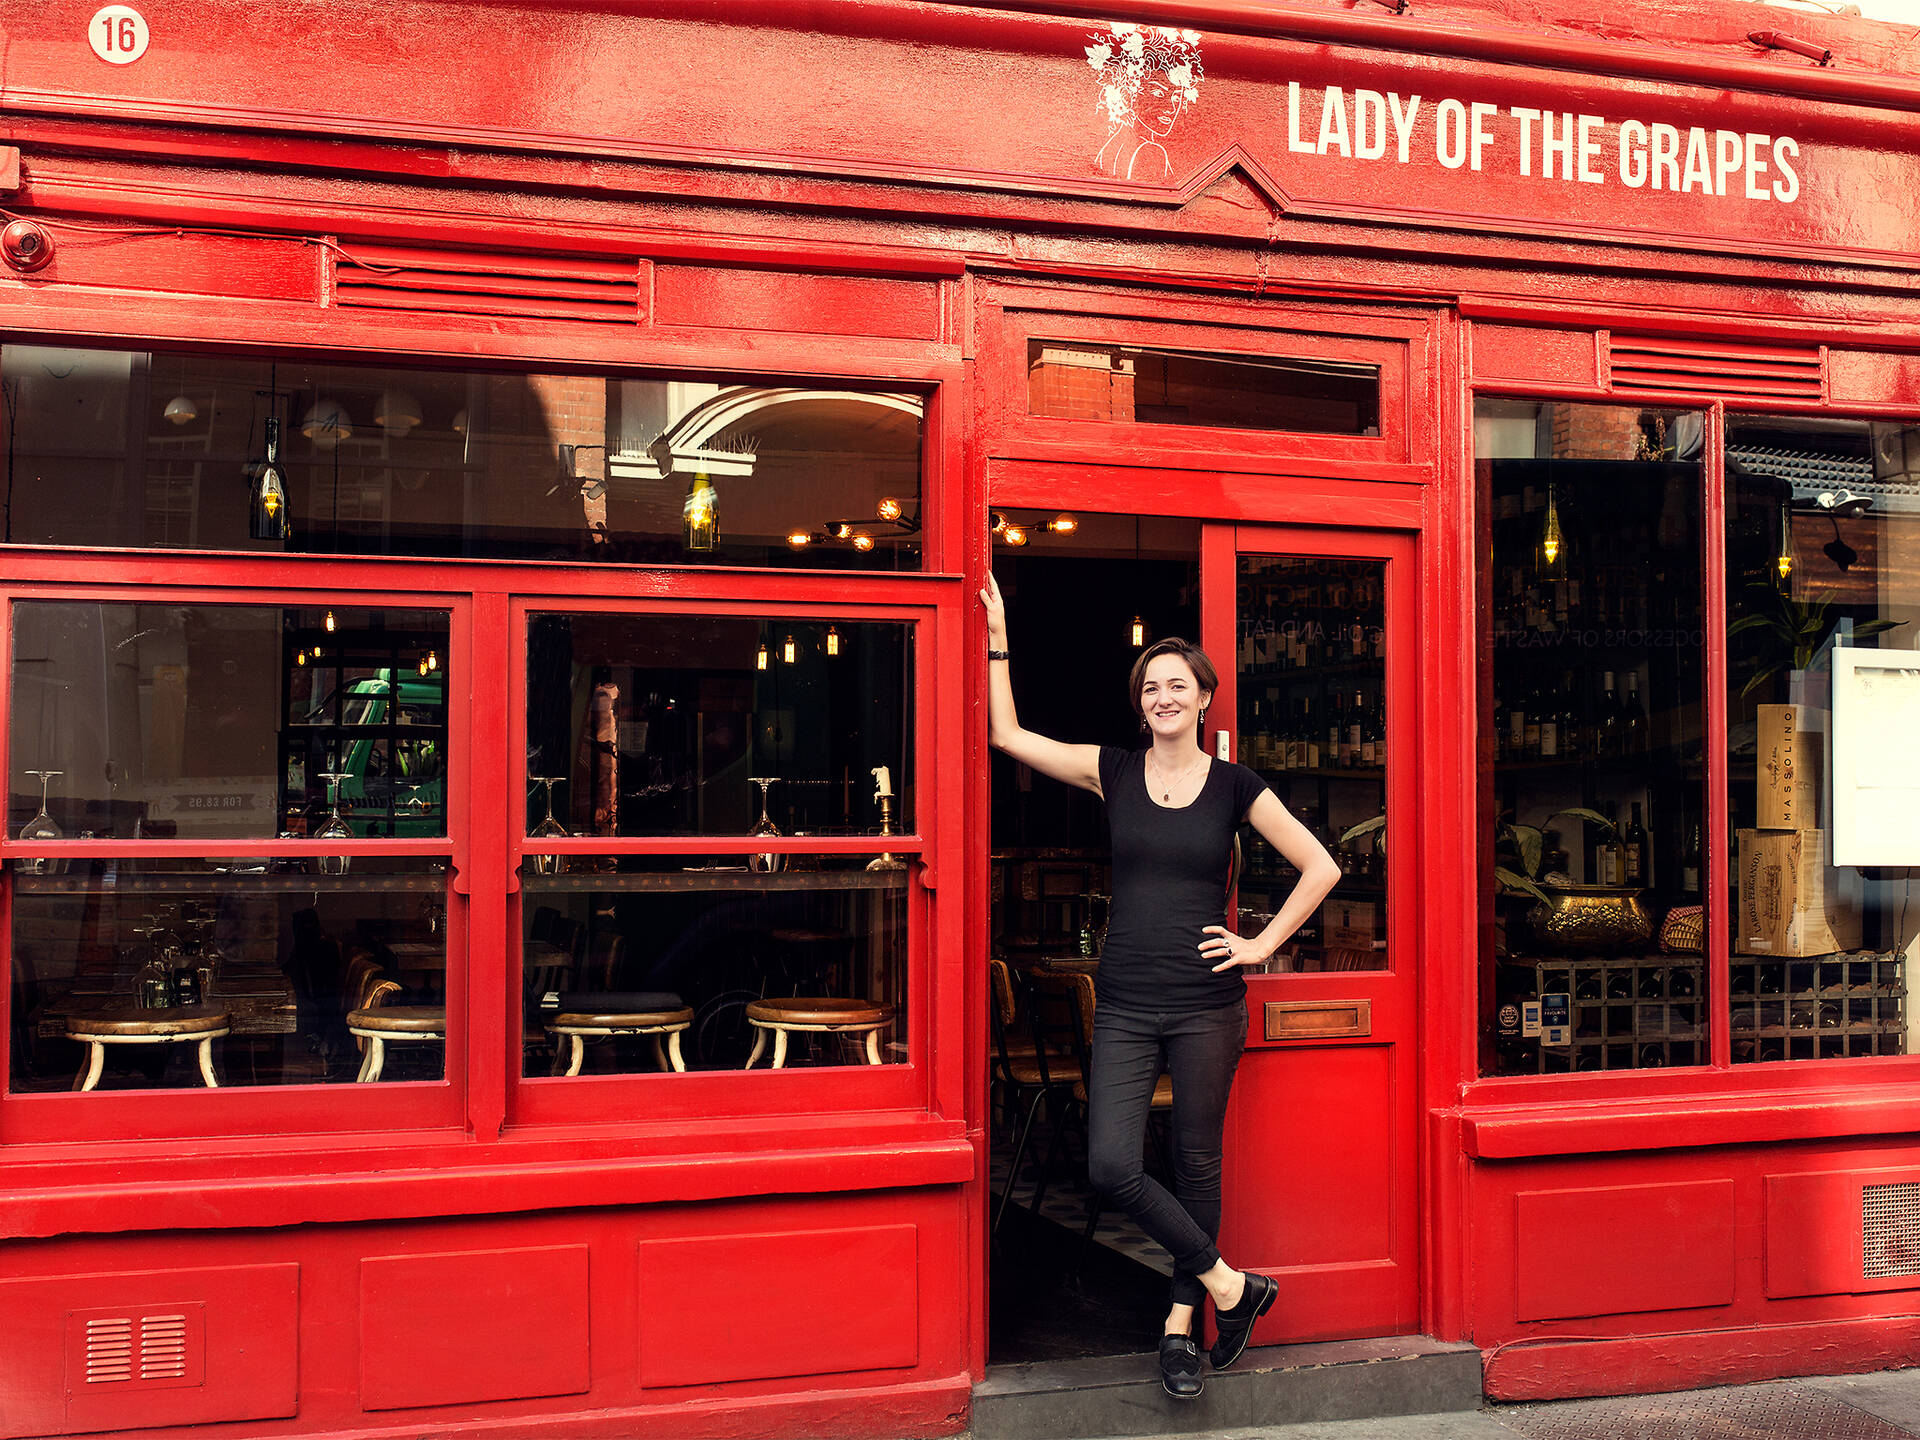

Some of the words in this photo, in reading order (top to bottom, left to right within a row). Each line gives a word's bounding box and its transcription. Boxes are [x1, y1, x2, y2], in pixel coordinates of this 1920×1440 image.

[102, 16, 136, 53] 16
[1288, 81, 1421, 164] LADY
[1436, 98, 1498, 171] OF
[1510, 106, 1606, 185] THE
[1619, 119, 1800, 204] GRAPES
[1784, 712, 1793, 821] MASSOLINO
[1747, 850, 1763, 901] PERGANSON
[1748, 901, 1762, 934] LAROSE
